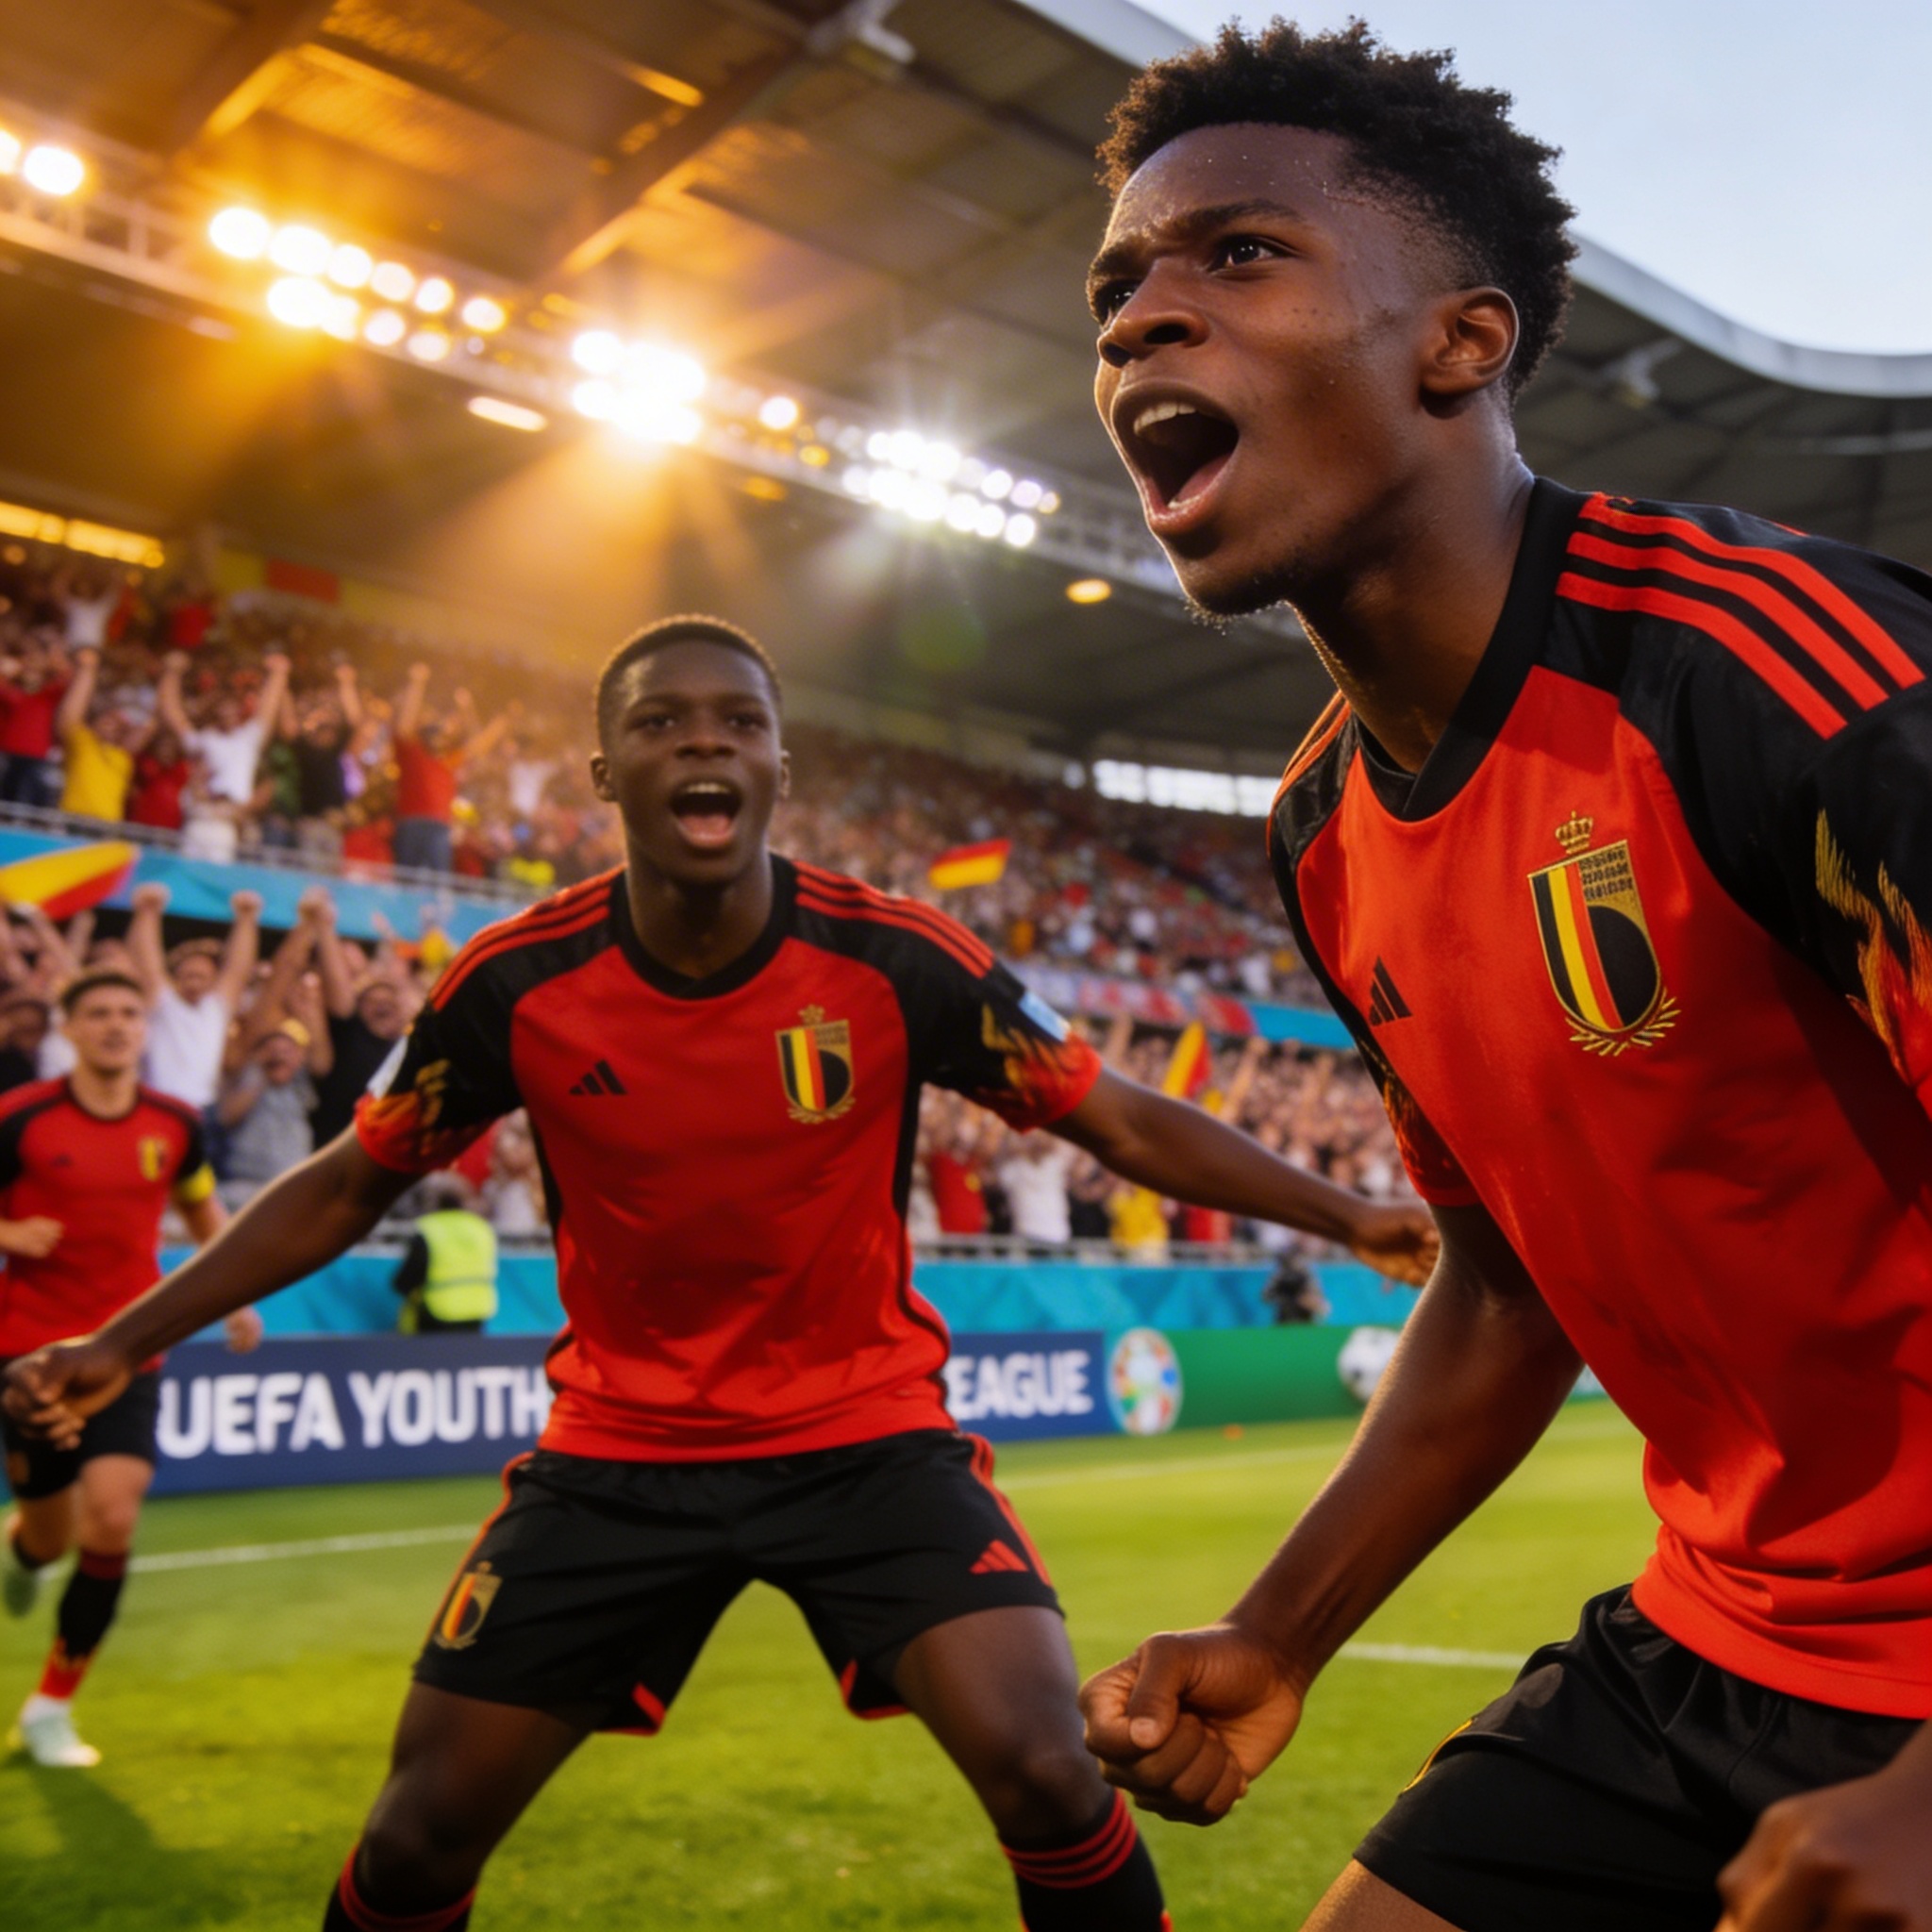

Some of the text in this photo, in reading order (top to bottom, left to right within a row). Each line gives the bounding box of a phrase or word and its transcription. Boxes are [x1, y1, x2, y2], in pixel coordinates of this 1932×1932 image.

[157, 1349, 1094, 1458] UEFA YOUTH EAGUE
